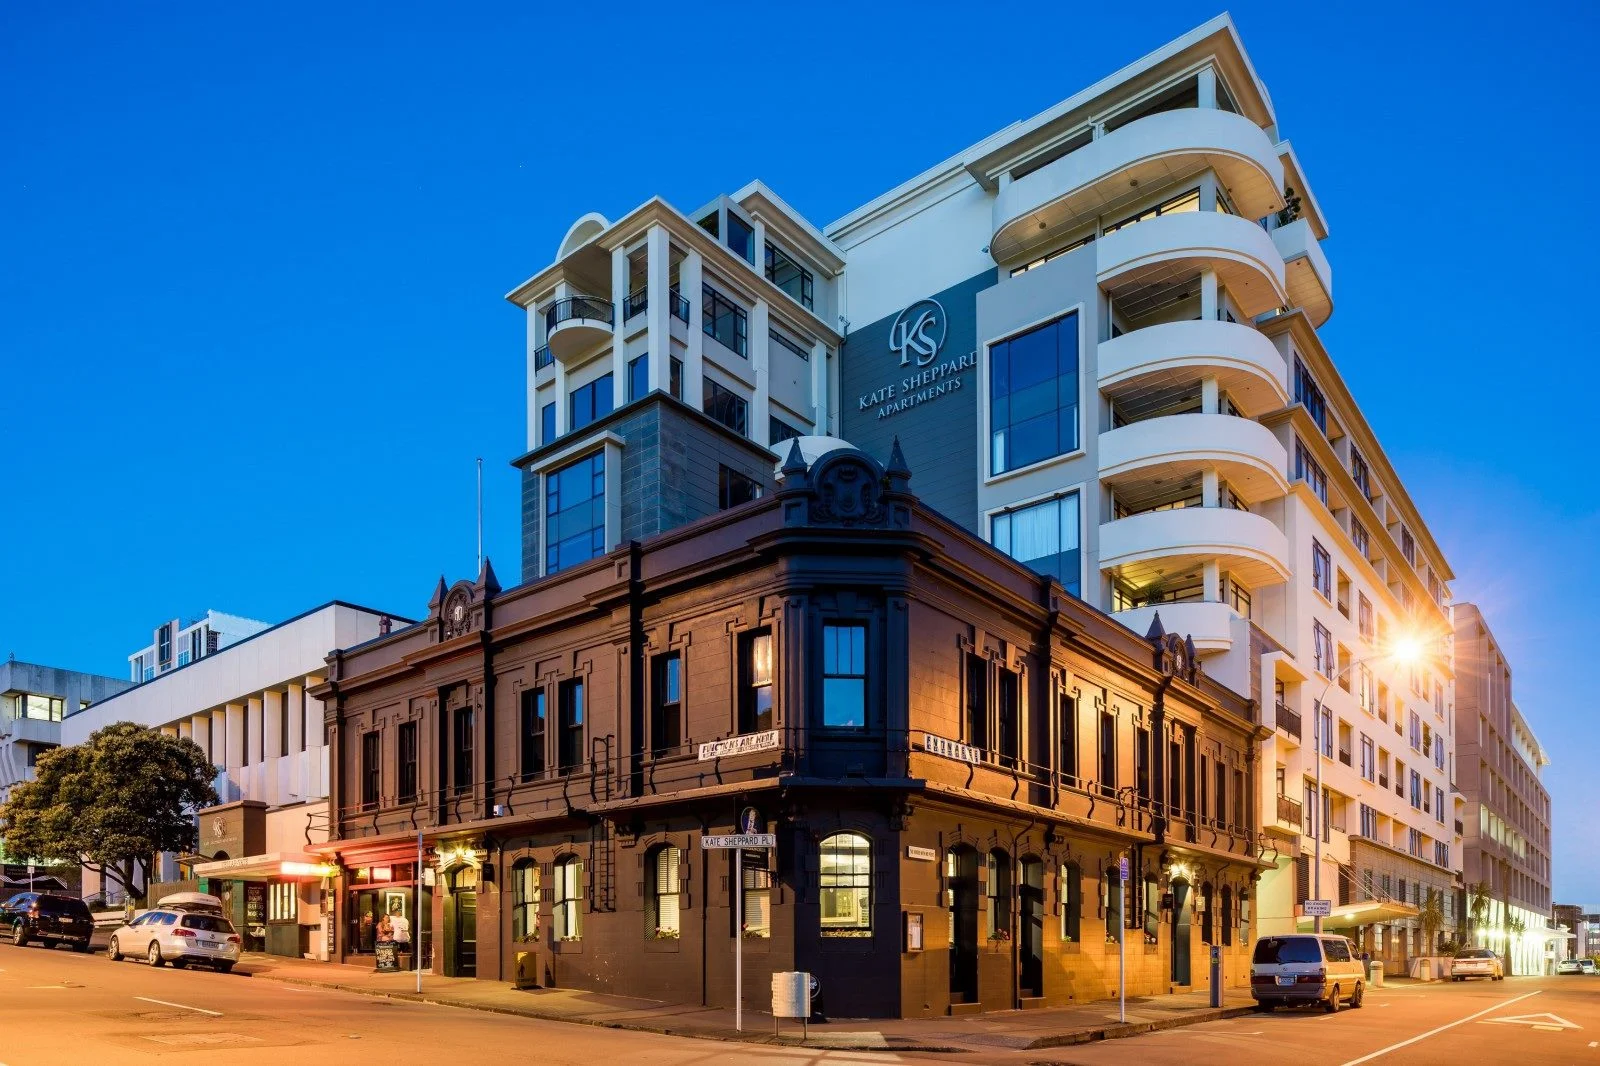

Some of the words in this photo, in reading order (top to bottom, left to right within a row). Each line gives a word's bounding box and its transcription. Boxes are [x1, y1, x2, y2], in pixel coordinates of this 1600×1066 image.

[897, 309, 937, 367] KS
[859, 384, 896, 411] KATE
[902, 350, 977, 393] SHEPPARD
[877, 377, 962, 419] APARTMENTS
[705, 837, 721, 847] KATE
[724, 836, 759, 846] SHEPPARD
[761, 836, 770, 845] PL
